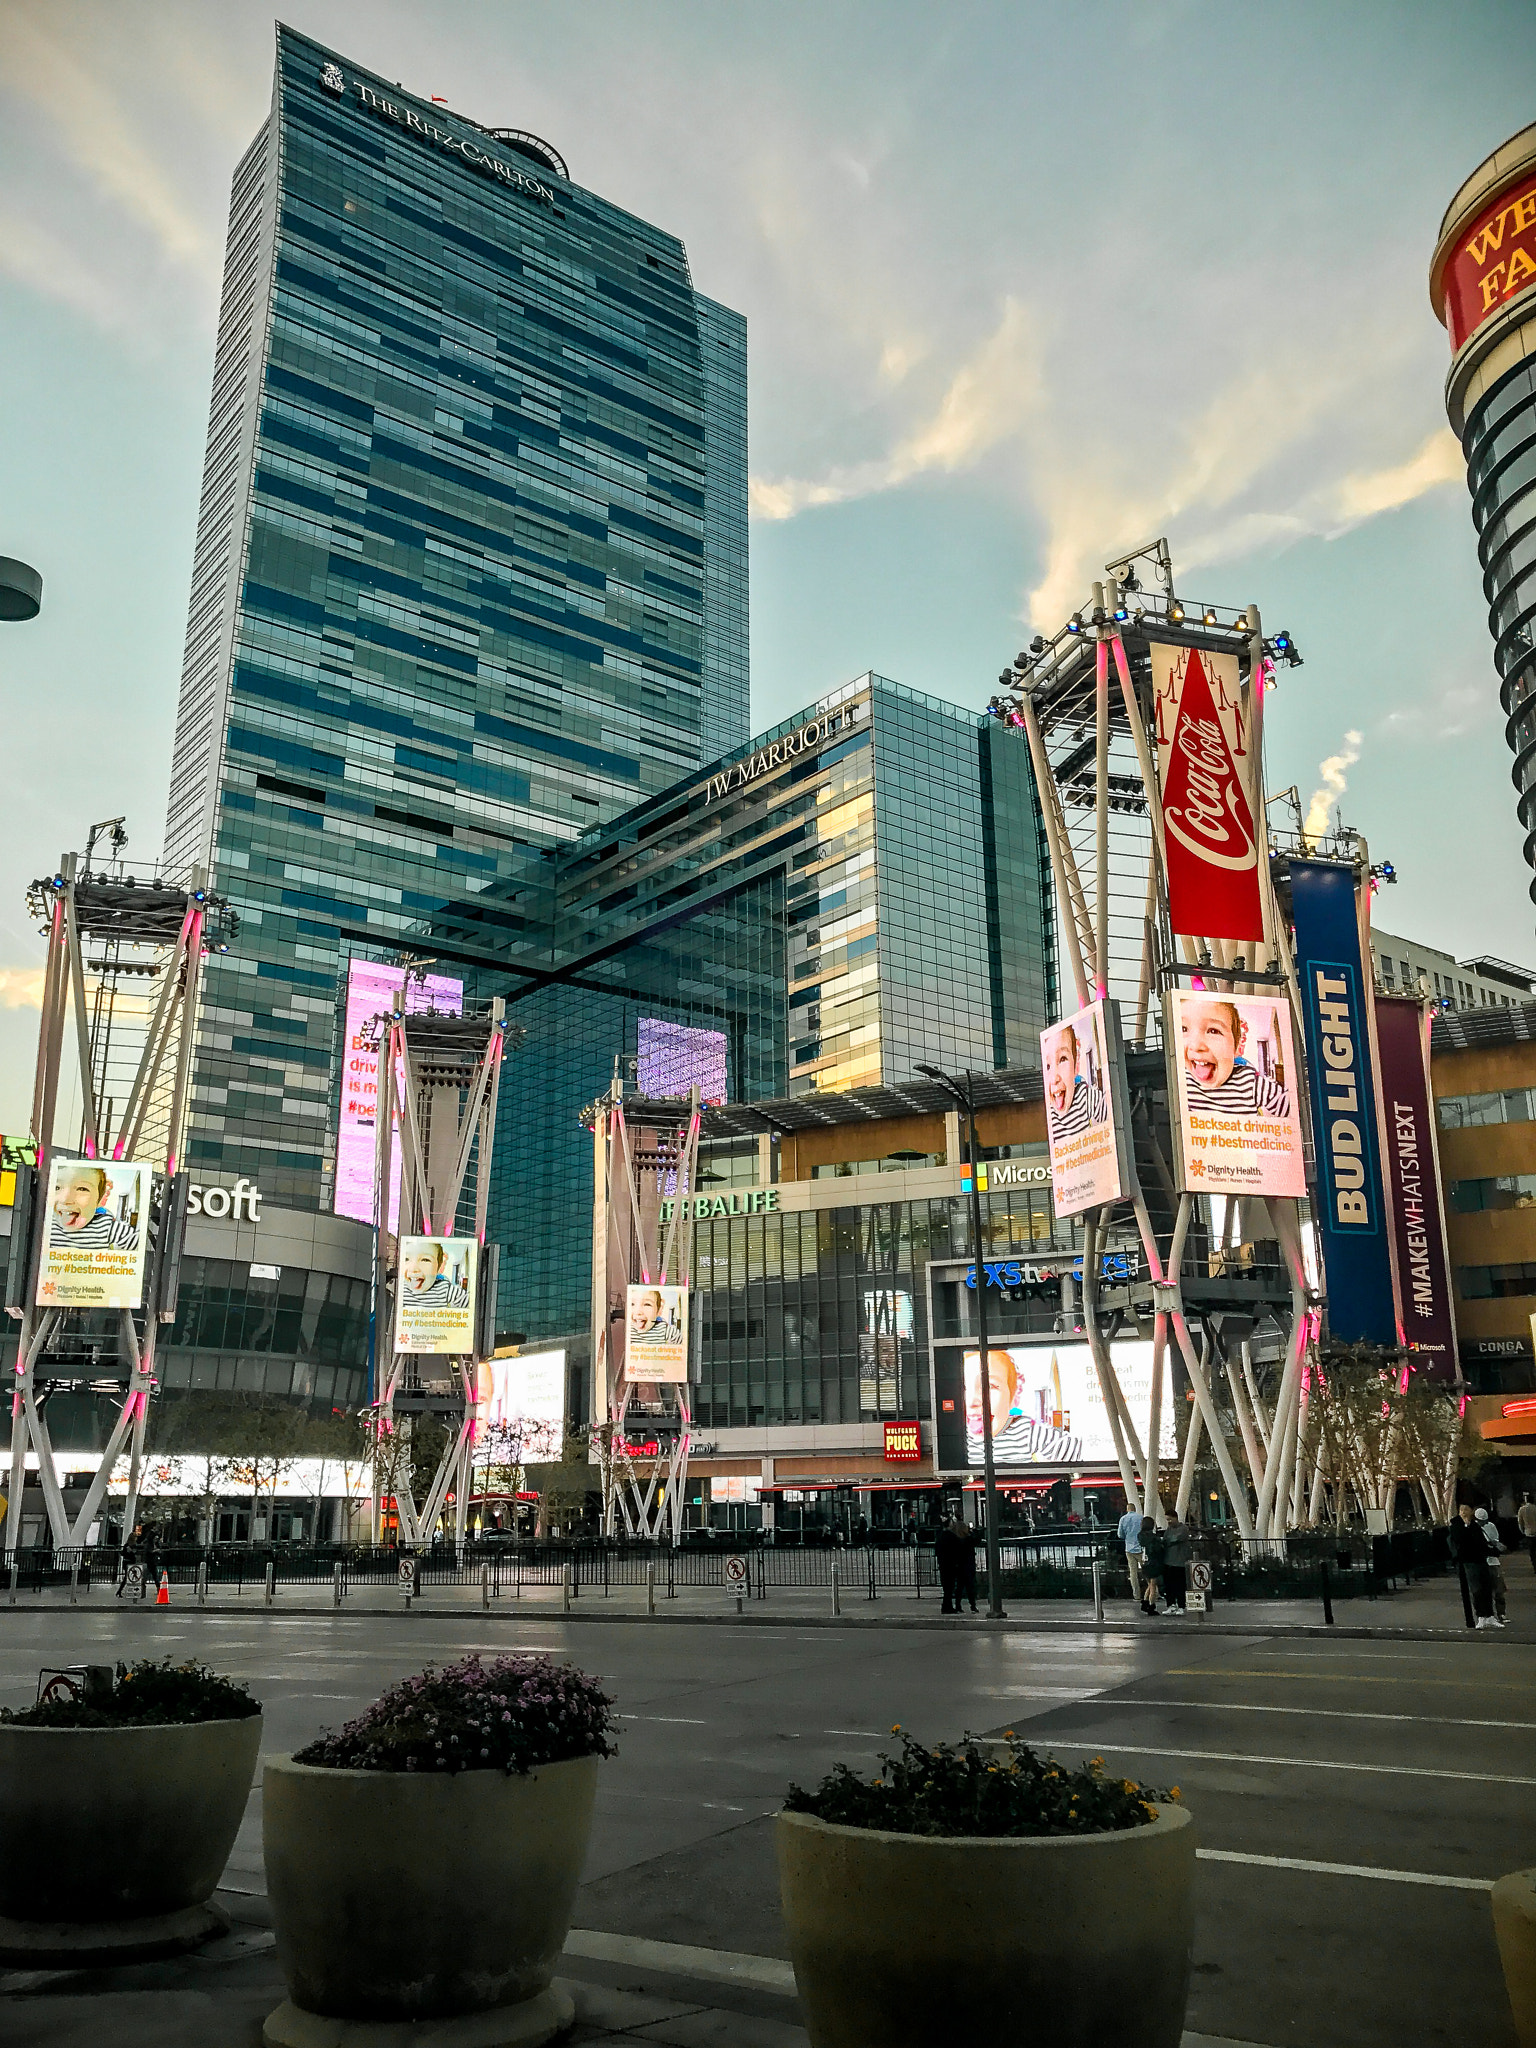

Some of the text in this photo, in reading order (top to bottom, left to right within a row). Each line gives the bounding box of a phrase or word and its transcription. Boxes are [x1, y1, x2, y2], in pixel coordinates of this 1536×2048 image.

[353, 81, 554, 201] THE RITZ-CARLTON
[705, 702, 852, 806] JW MARRIOTT
[1164, 711, 1257, 871] Coca-Cola
[1316, 971, 1369, 1224] BUD LIGHT
[1190, 1117, 1292, 1136] Backseat driving is
[1055, 1138, 1082, 1159] Backseat
[1083, 1130, 1104, 1148] driving
[1191, 1135, 1294, 1151] my #bestmedicine.
[993, 1164, 1053, 1185] Micros
[1056, 1163, 1065, 1175] my
[1208, 1165, 1235, 1176] Dignity
[1393, 1101, 1433, 1318] #MAKEWHATSNEXT
[49, 1251, 137, 1265] Backseat driving is
[48, 1264, 136, 1276] my #bestmedicine.
[57, 1285, 81, 1294] Dignity
[403, 1309, 435, 1318] Backseat
[437, 1310, 461, 1320] driving
[402, 1319, 468, 1328] my #bestmedicine.
[411, 1333, 430, 1341] Dignity
[1420, 1343, 1446, 1352] Microsoft
[1479, 1341, 1525, 1353] CONGA
[886, 1427, 917, 1435] WOLFGANG
[886, 1435, 918, 1451] PUCK
